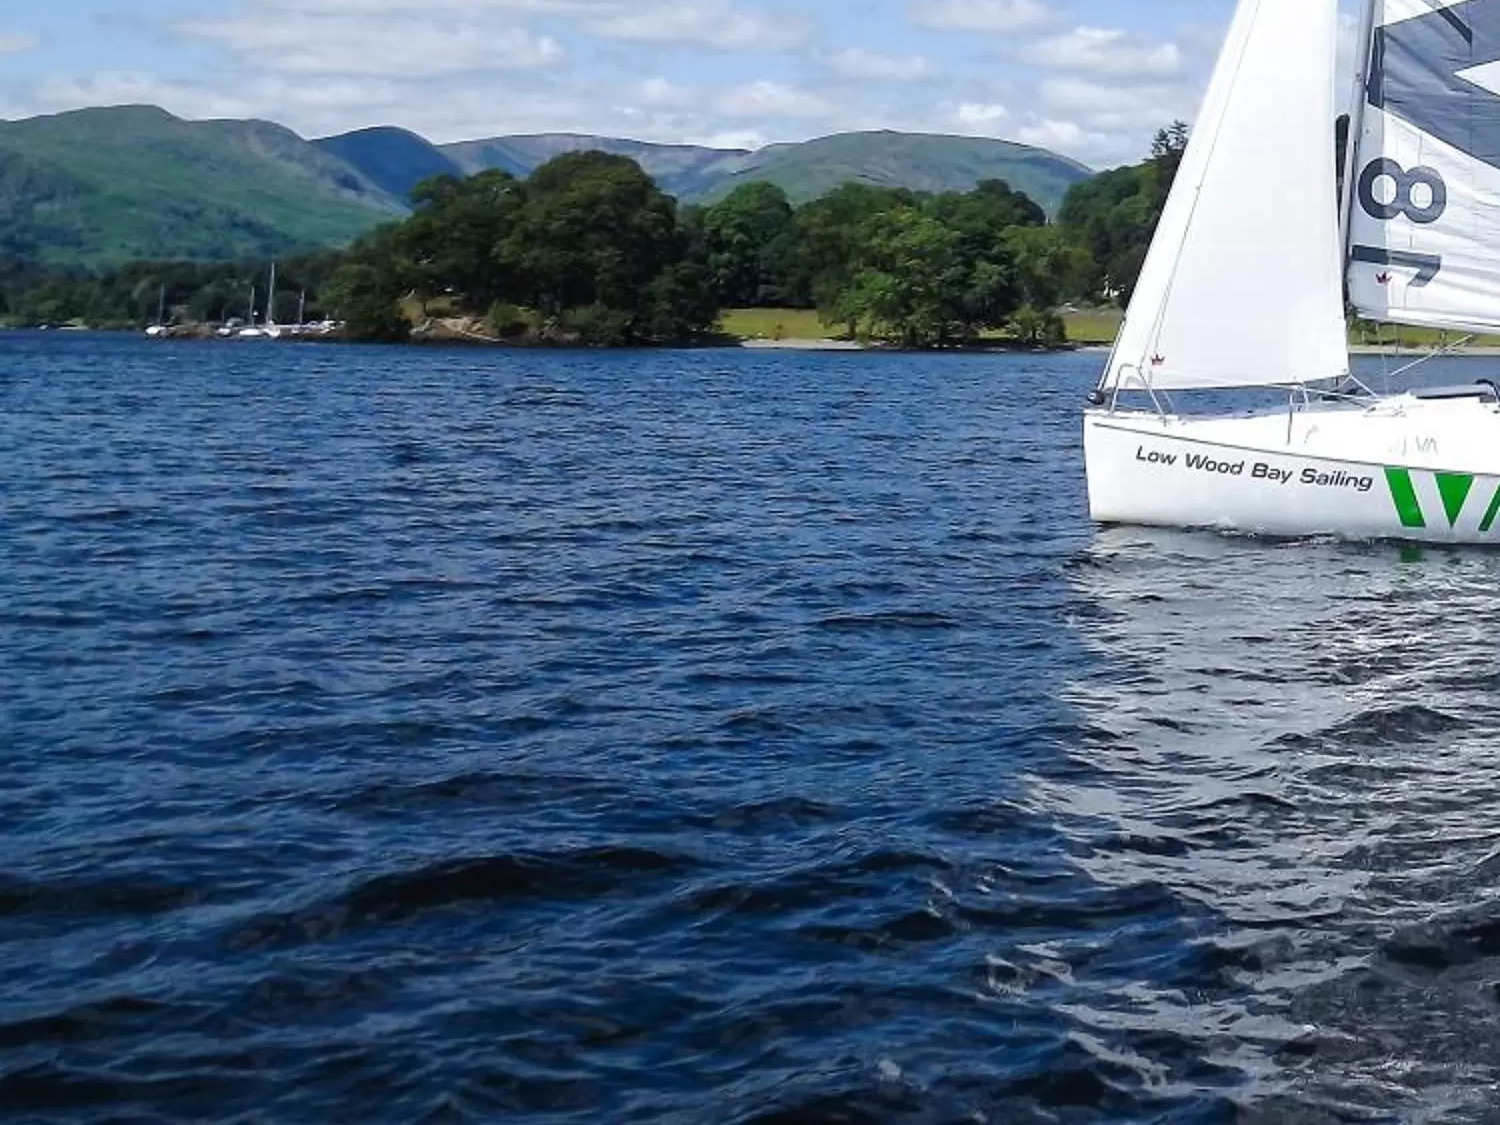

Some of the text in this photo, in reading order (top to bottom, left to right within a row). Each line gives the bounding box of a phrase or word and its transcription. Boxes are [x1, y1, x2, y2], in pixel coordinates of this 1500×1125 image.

[1135, 445, 1374, 492] Low Wood Bay Sailing
